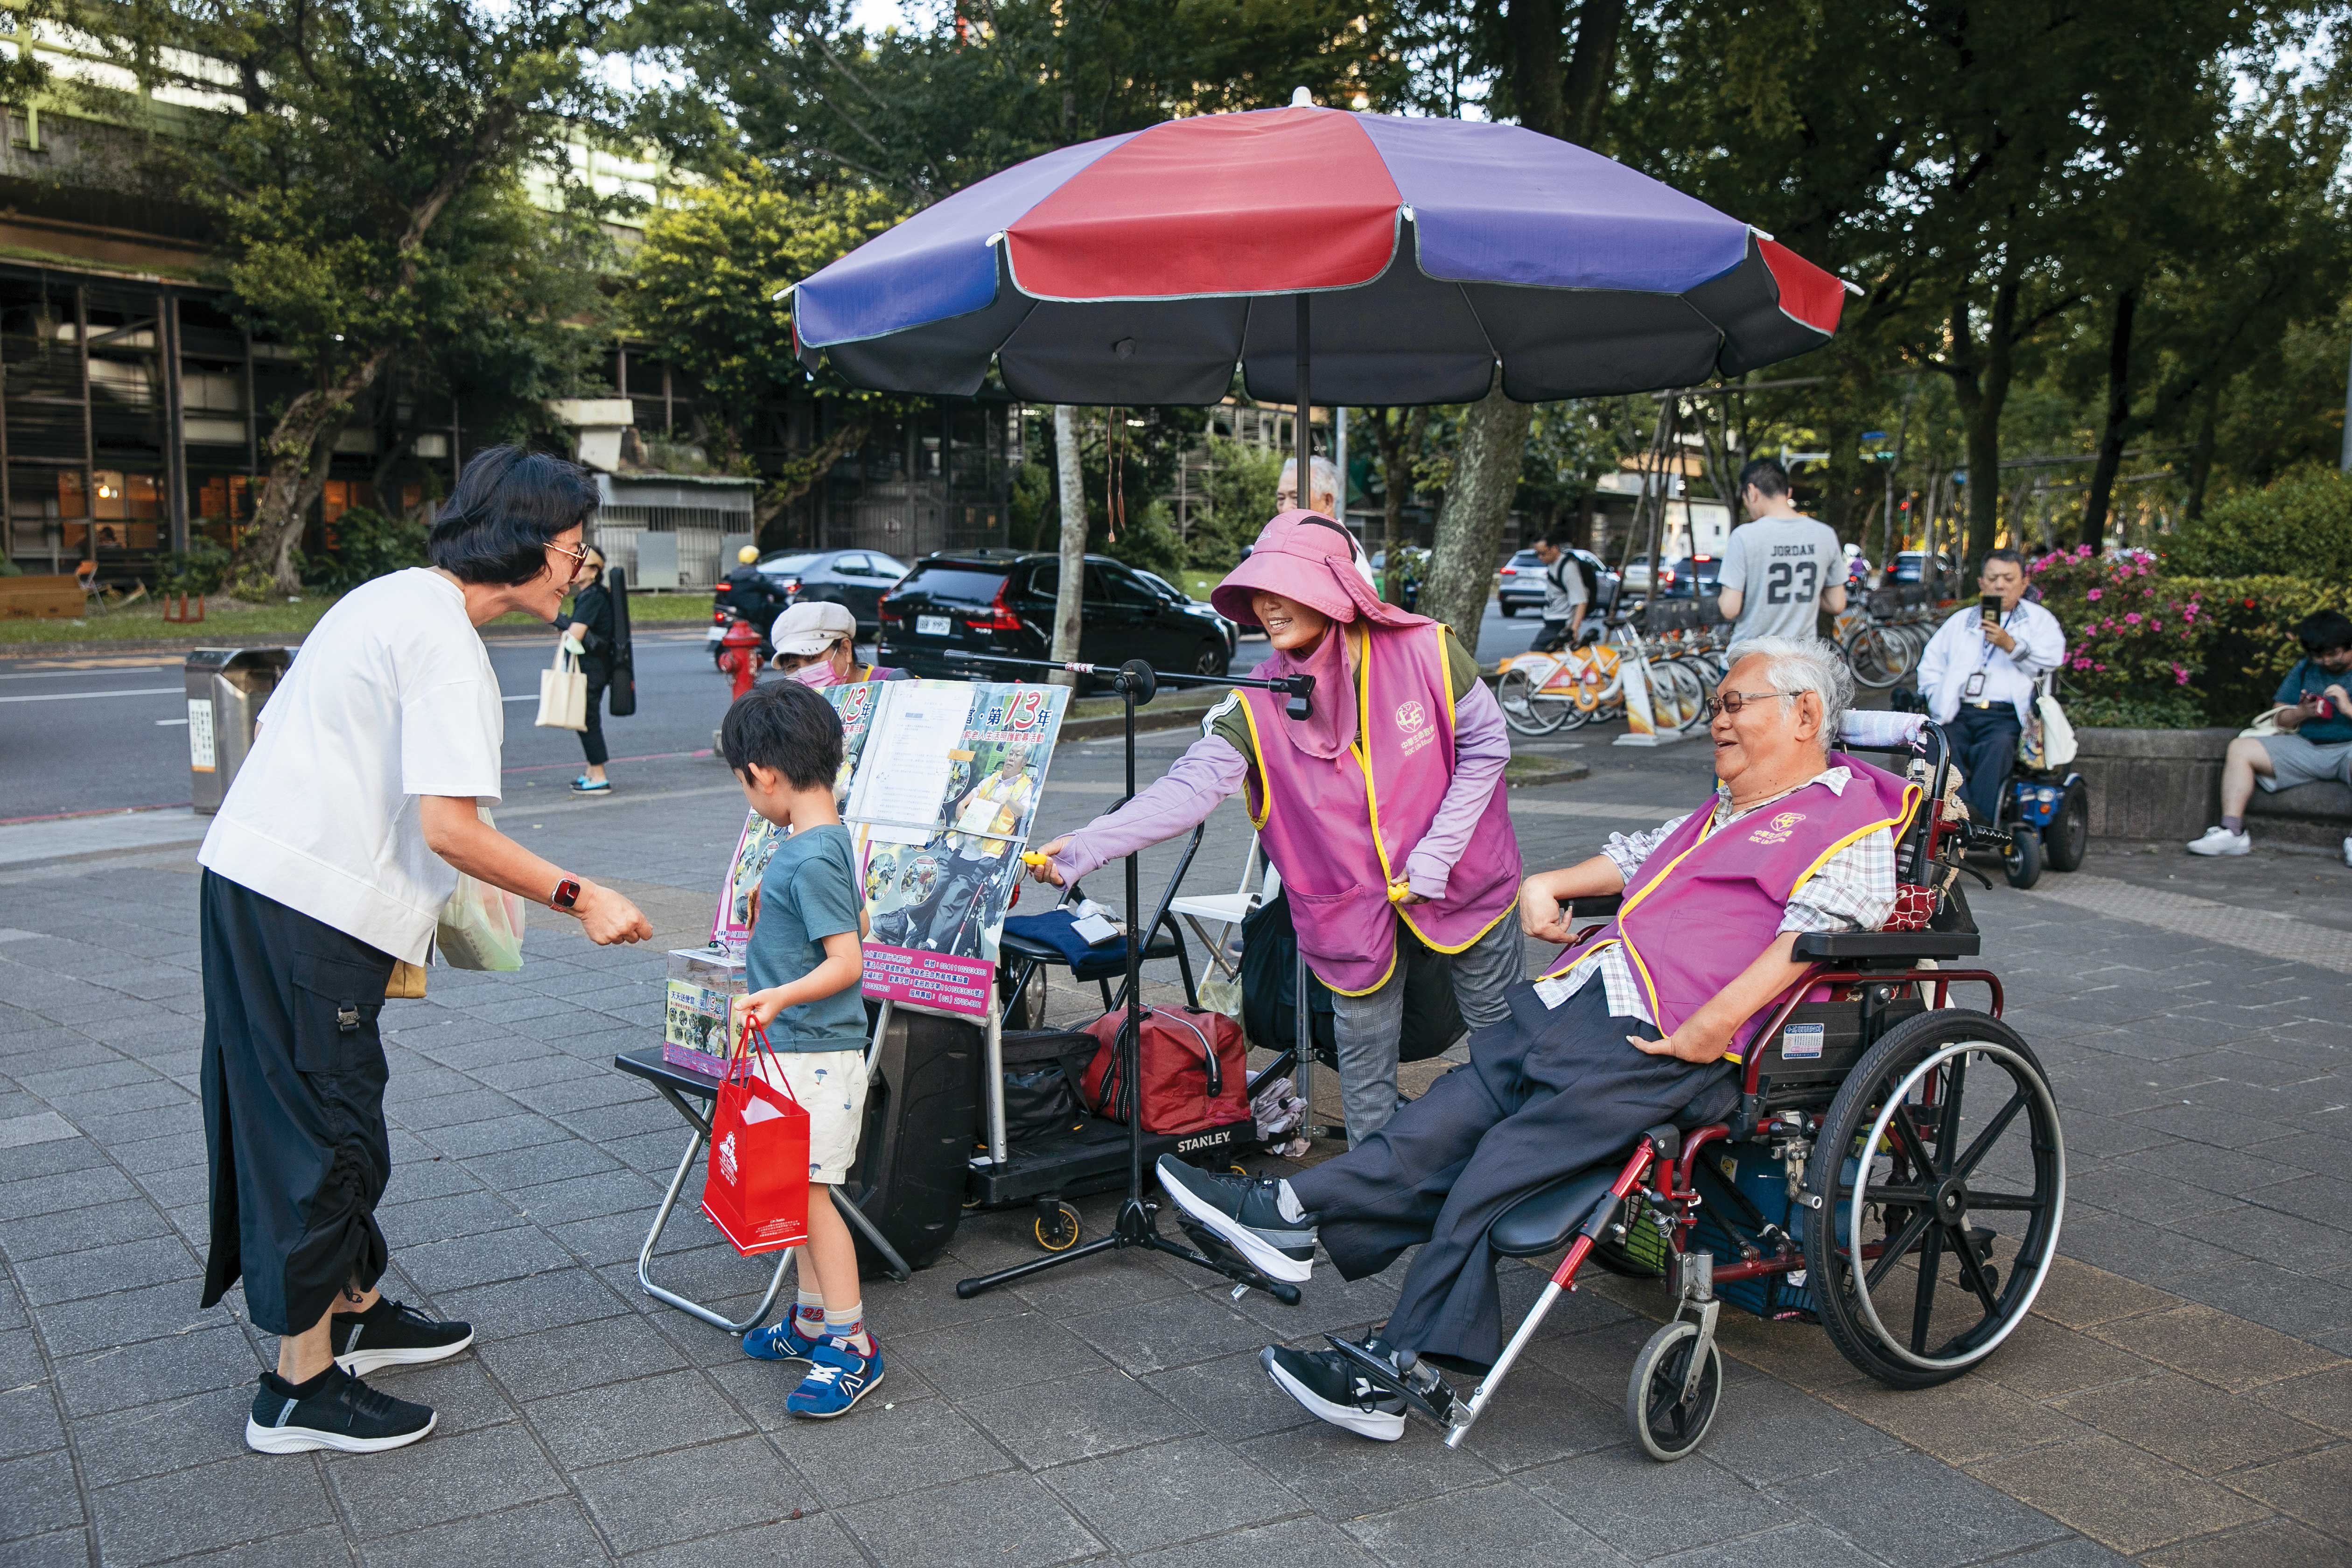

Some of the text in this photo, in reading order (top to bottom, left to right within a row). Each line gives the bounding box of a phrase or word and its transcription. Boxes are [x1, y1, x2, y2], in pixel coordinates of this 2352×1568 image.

[1771, 544, 1814, 556] JORDAN
[1767, 561, 1817, 604] 23
[1405, 747, 1415, 756] ROC
[864, 950, 912, 965] 台北富邦銀行市府分行
[1178, 1131, 1230, 1153] STANLEY
[801, 1307, 824, 1321] 95
